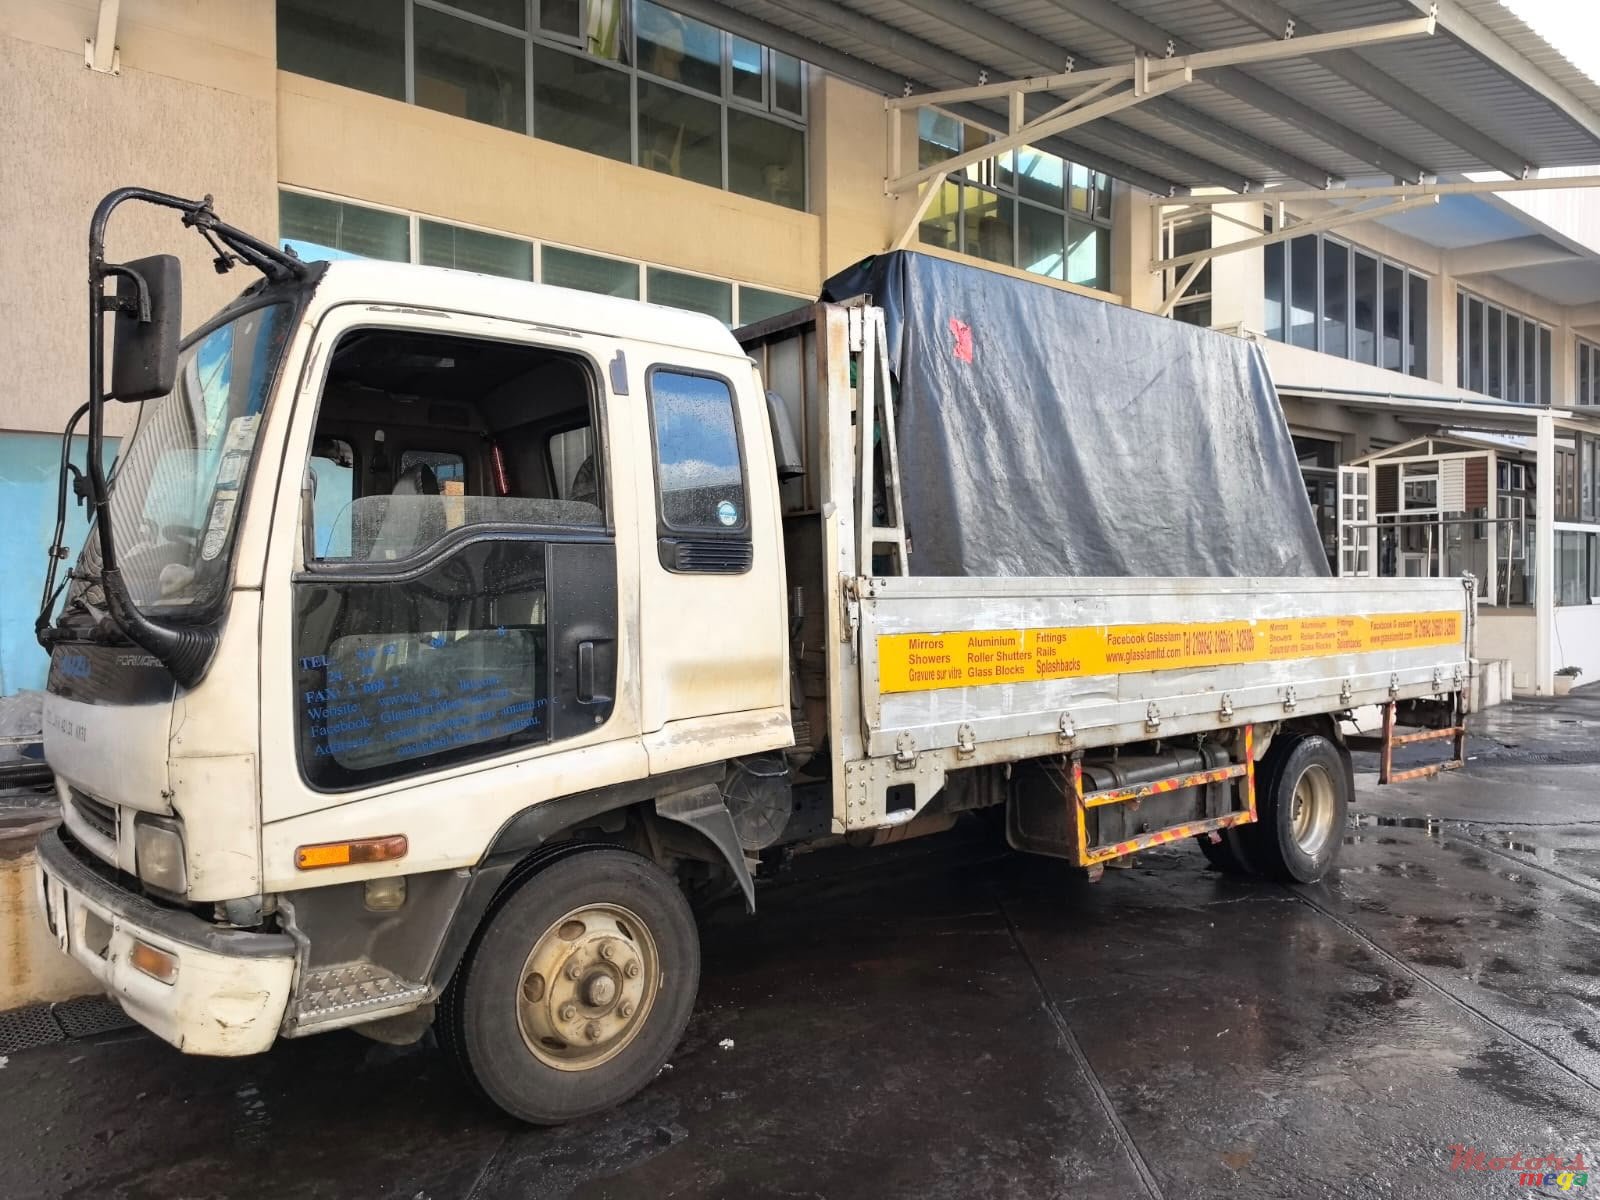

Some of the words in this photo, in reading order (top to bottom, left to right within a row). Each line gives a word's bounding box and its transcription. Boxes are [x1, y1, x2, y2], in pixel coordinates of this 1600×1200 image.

[908, 637, 944, 650] Mirrors
[967, 635, 1016, 648] Aluminium
[1036, 632, 1067, 645] Fittings
[1107, 633, 1146, 646] Facebook
[1183, 631, 1191, 657] Tel
[967, 652, 994, 663] Roller
[996, 650, 1033, 662] Shutters
[1036, 646, 1057, 657] Rails
[908, 652, 951, 665] Showers
[967, 666, 993, 678] Glass
[995, 664, 1025, 676] Blocks
[1036, 657, 1081, 677] Splashbacks
[908, 668, 935, 682] Gravure
[948, 666, 963, 680] vitre
